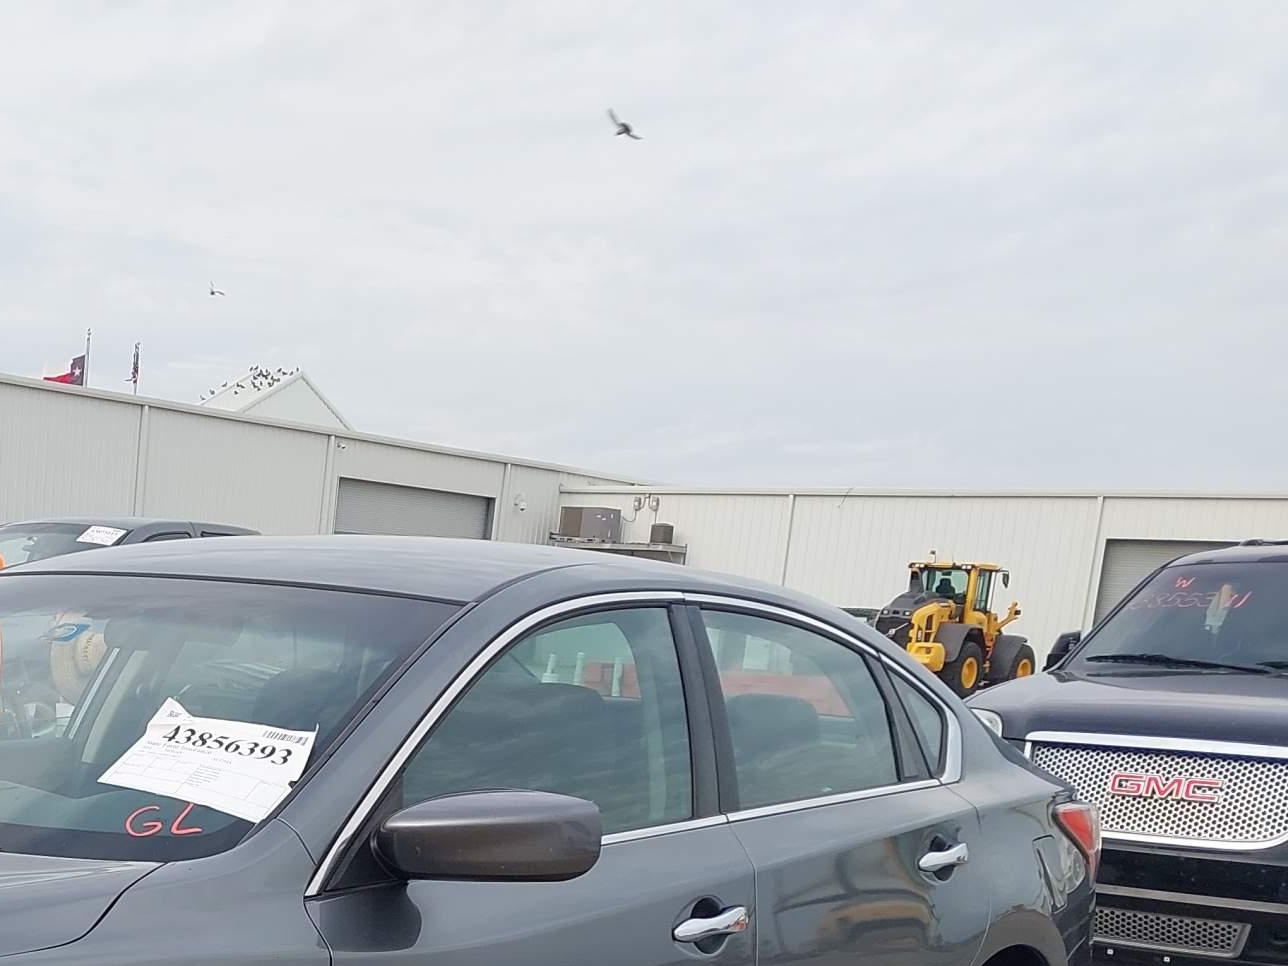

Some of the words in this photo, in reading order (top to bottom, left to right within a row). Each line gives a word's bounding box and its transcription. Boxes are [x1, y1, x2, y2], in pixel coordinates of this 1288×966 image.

[162, 724, 293, 767] 43856393
[1110, 772, 1224, 803] GMC
[125, 803, 203, 837] GL
